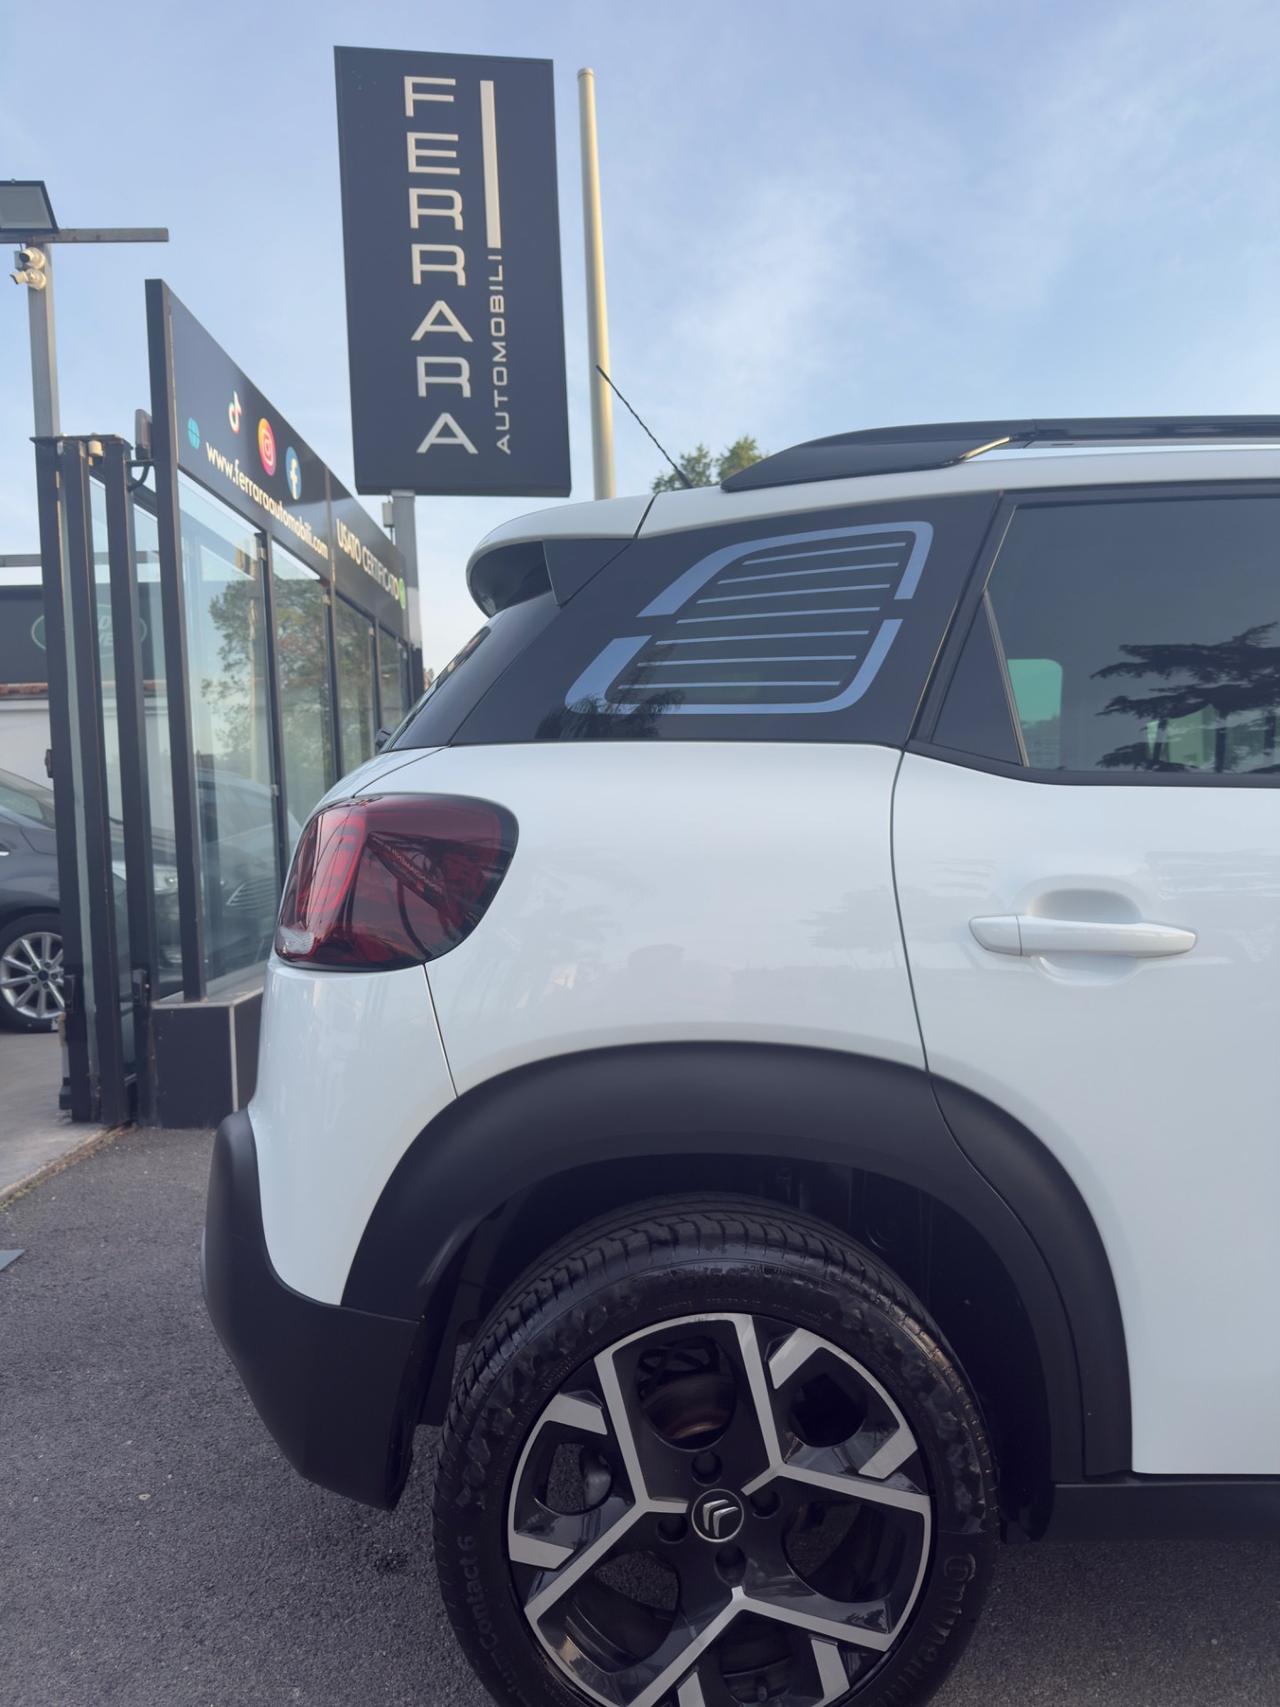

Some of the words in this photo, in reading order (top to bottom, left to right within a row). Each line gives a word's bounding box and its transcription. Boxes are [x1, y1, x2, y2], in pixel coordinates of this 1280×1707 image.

[403, 75, 478, 455] FERRARA
[487, 254, 512, 456] AUTOMOBILI
[206, 441, 329, 560] www.ferraraautomobili.com
[336, 518, 362, 566] USATO
